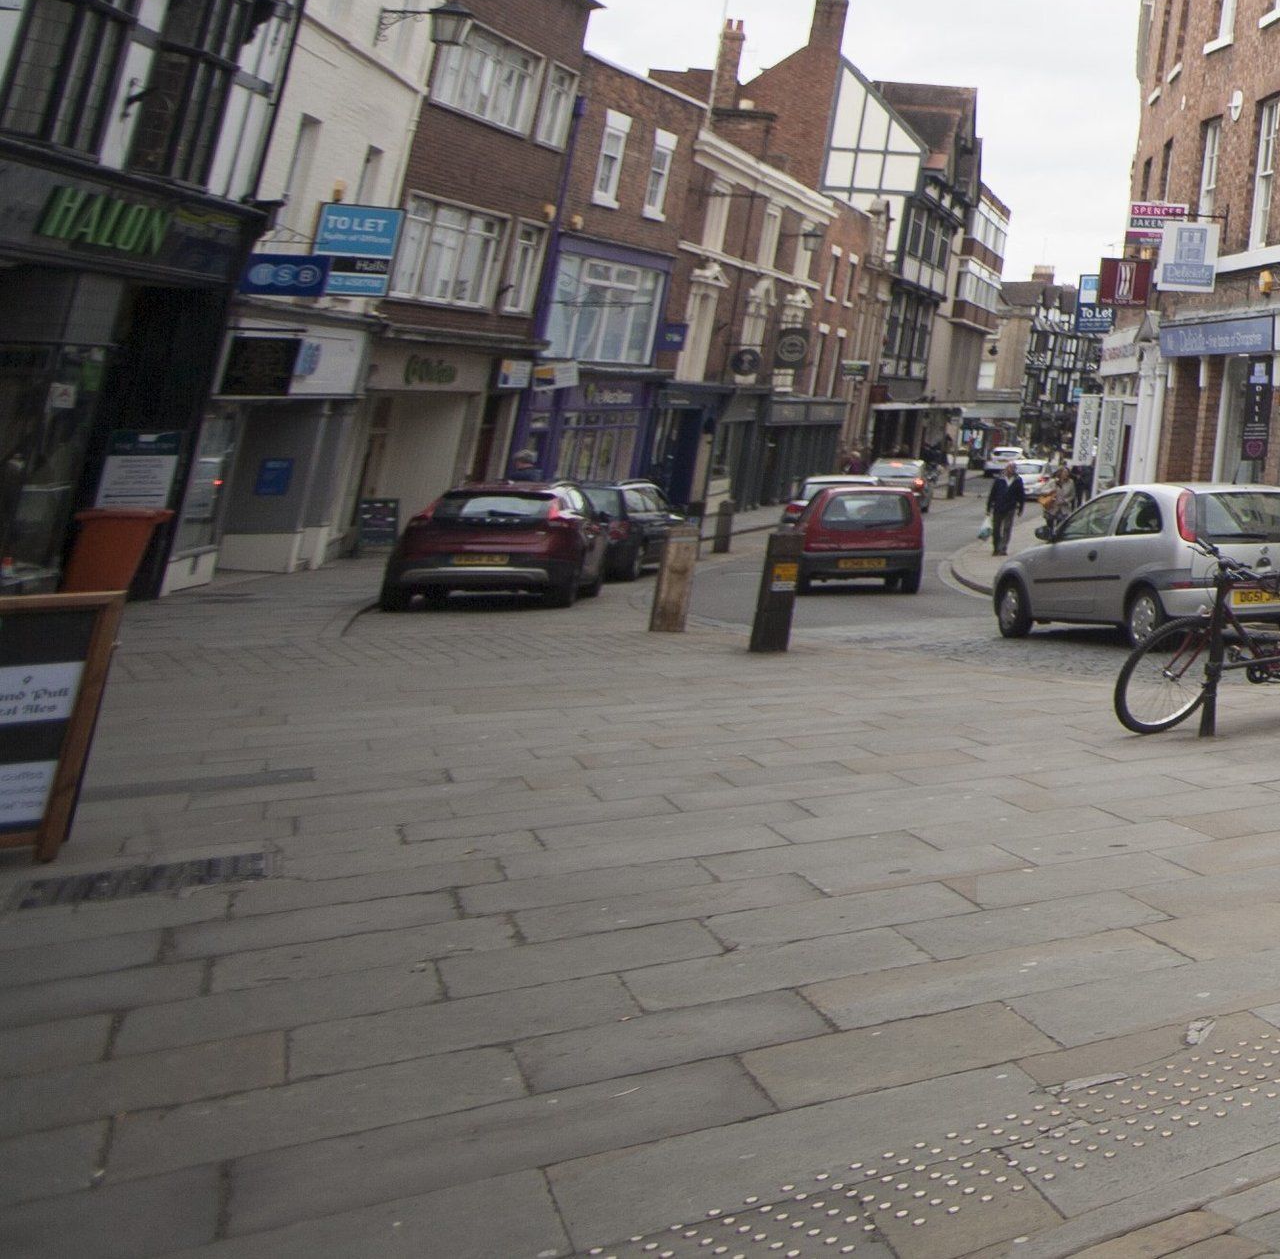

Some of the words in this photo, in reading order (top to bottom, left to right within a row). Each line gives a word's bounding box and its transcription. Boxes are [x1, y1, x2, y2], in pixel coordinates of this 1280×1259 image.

[1133, 206, 1183, 216] SPENCER
[327, 215, 349, 230] TO
[352, 217, 389, 232] LET
[258, 269, 315, 282] TSB
[1080, 307, 1094, 318] To
[1095, 307, 1113, 318] Let
